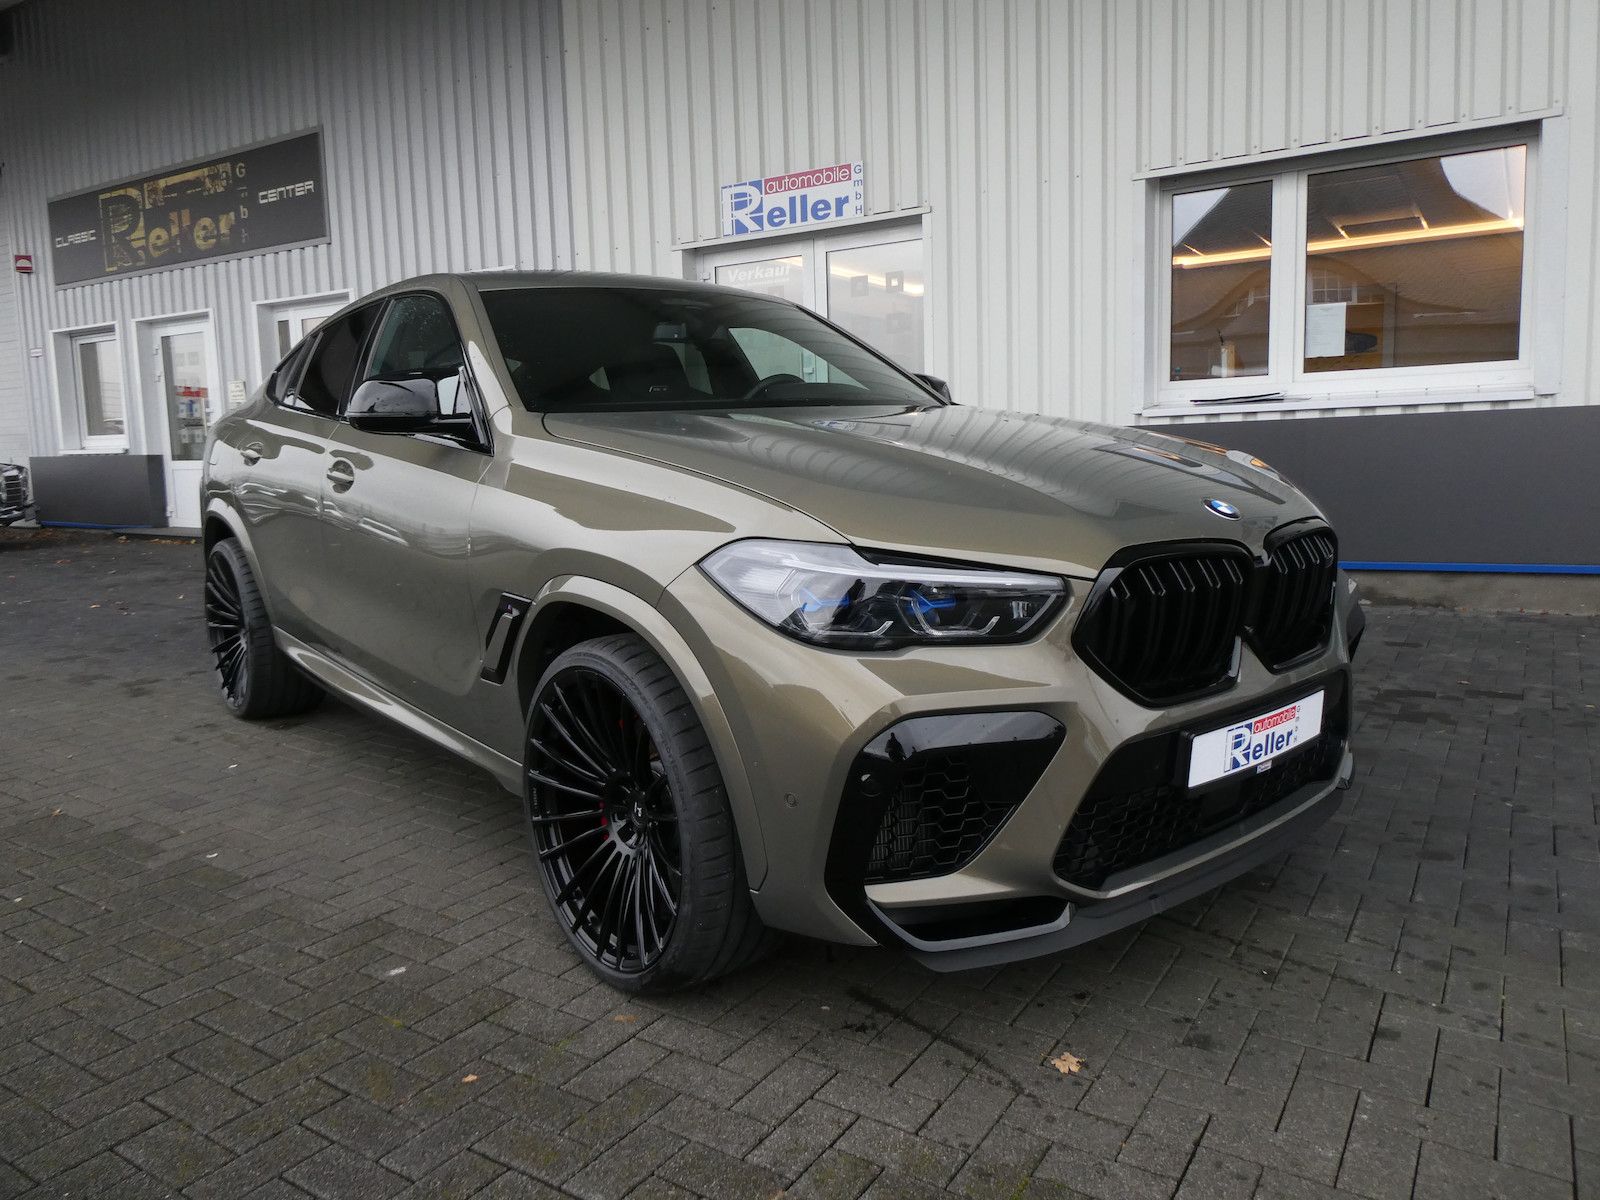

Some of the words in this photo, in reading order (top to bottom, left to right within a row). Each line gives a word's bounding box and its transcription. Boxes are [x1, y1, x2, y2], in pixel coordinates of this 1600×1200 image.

[258, 180, 315, 205] CENTER
[765, 166, 850, 194] automobile
[853, 164, 863, 215] GmbH
[721, 180, 850, 236] Reller
[1254, 707, 1296, 733] automobile
[1224, 721, 1294, 773] Reller
